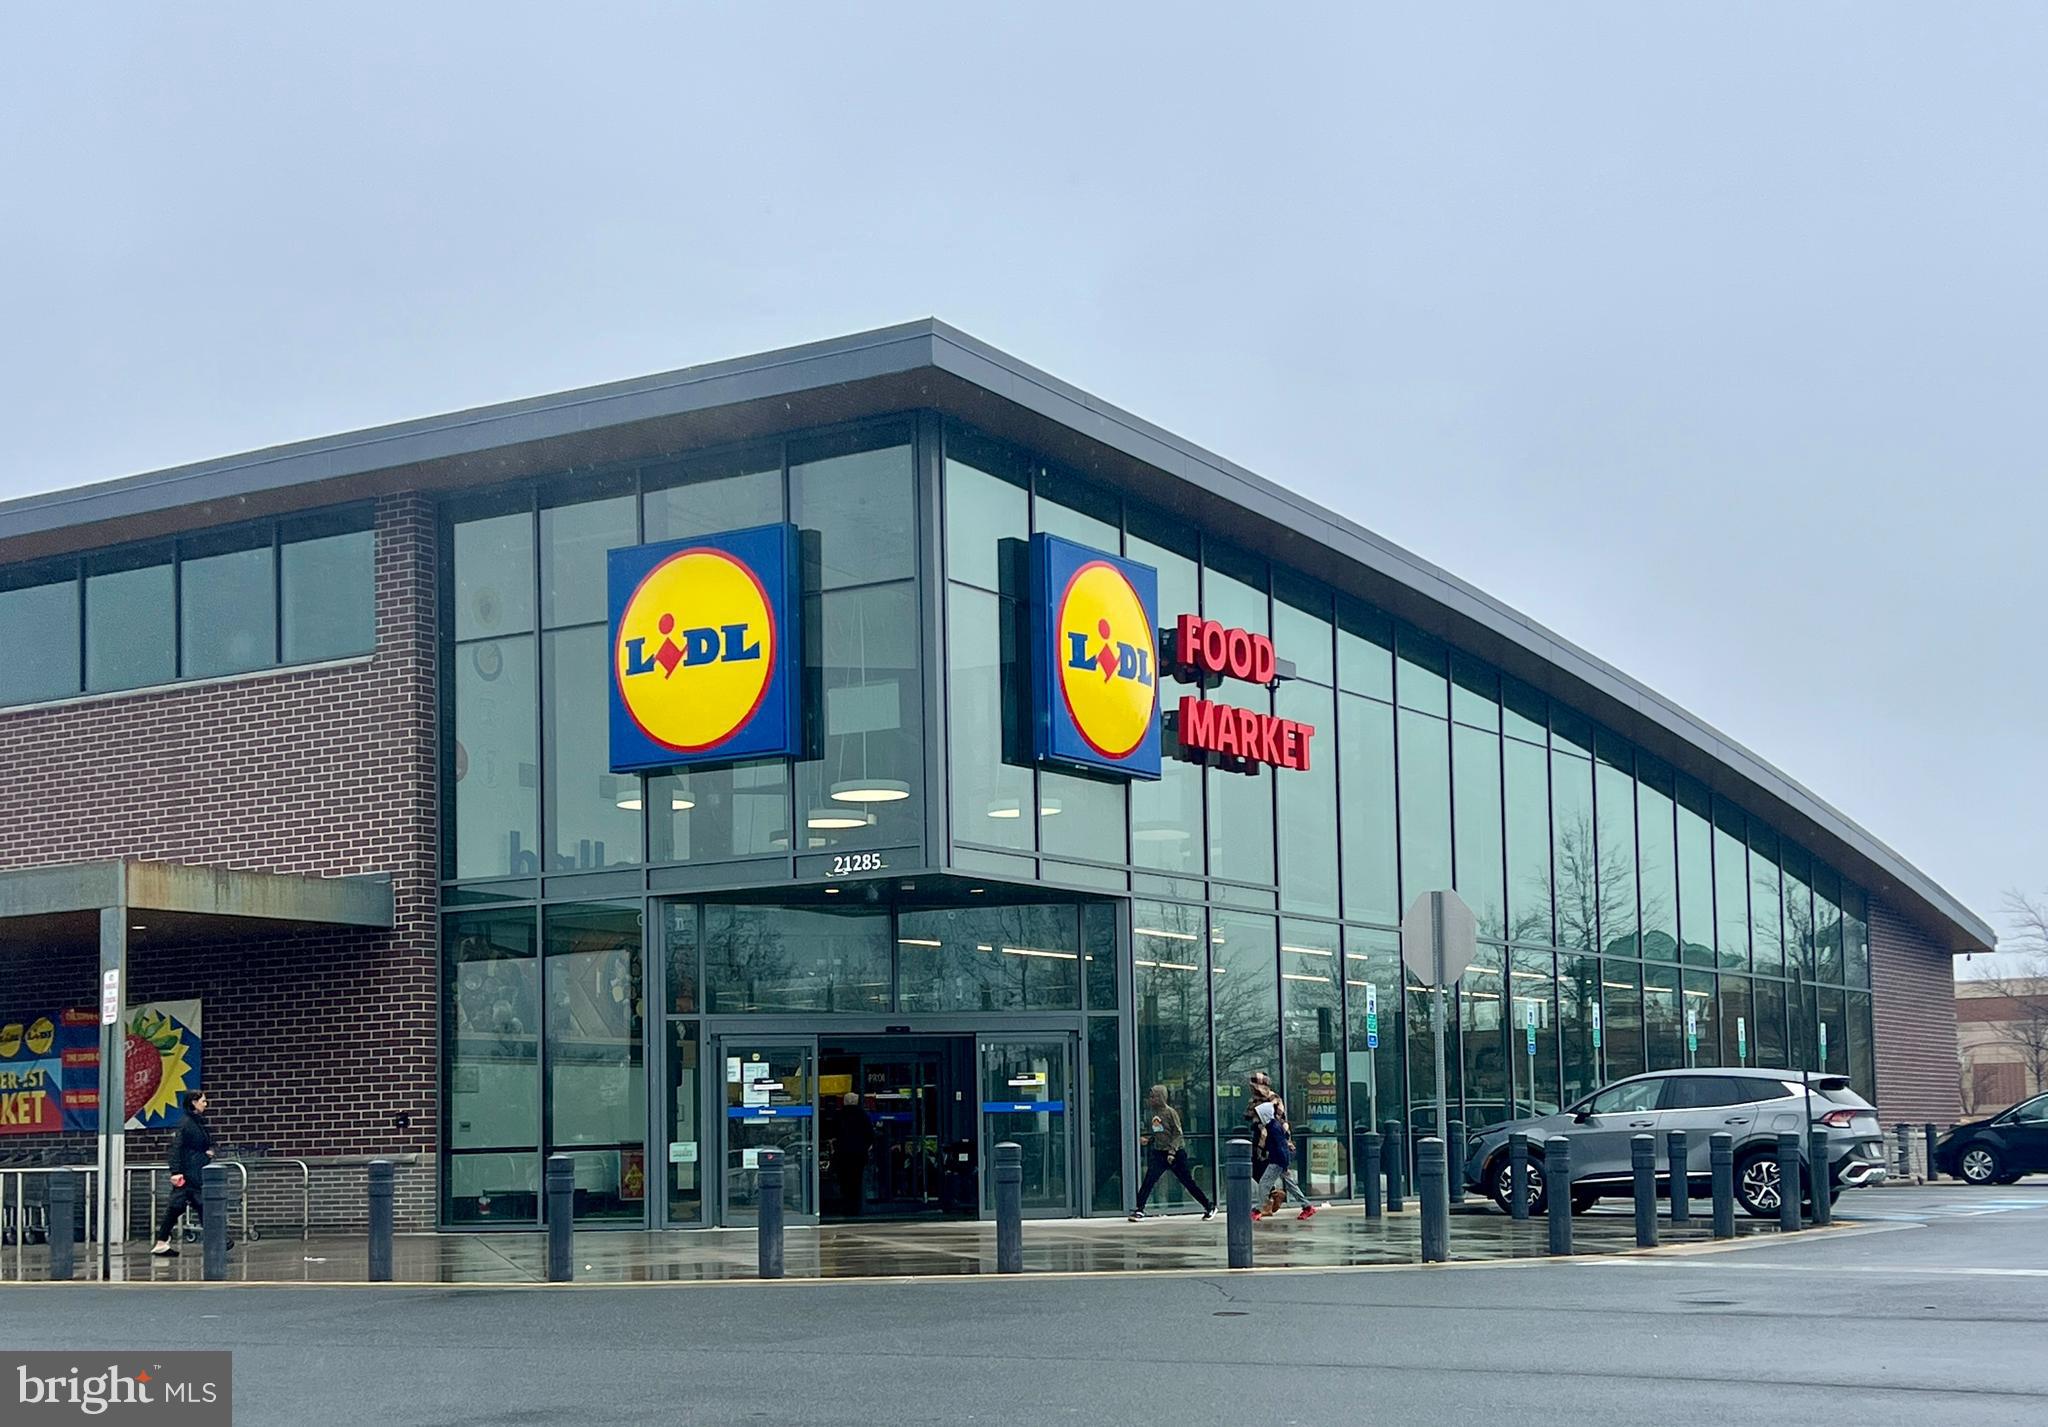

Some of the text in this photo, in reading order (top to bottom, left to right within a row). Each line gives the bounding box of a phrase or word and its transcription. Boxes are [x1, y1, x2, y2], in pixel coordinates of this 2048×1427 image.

[1178, 614, 1276, 684] FOOD
[1180, 696, 1315, 771] MARKET
[833, 853, 881, 873] 21285
